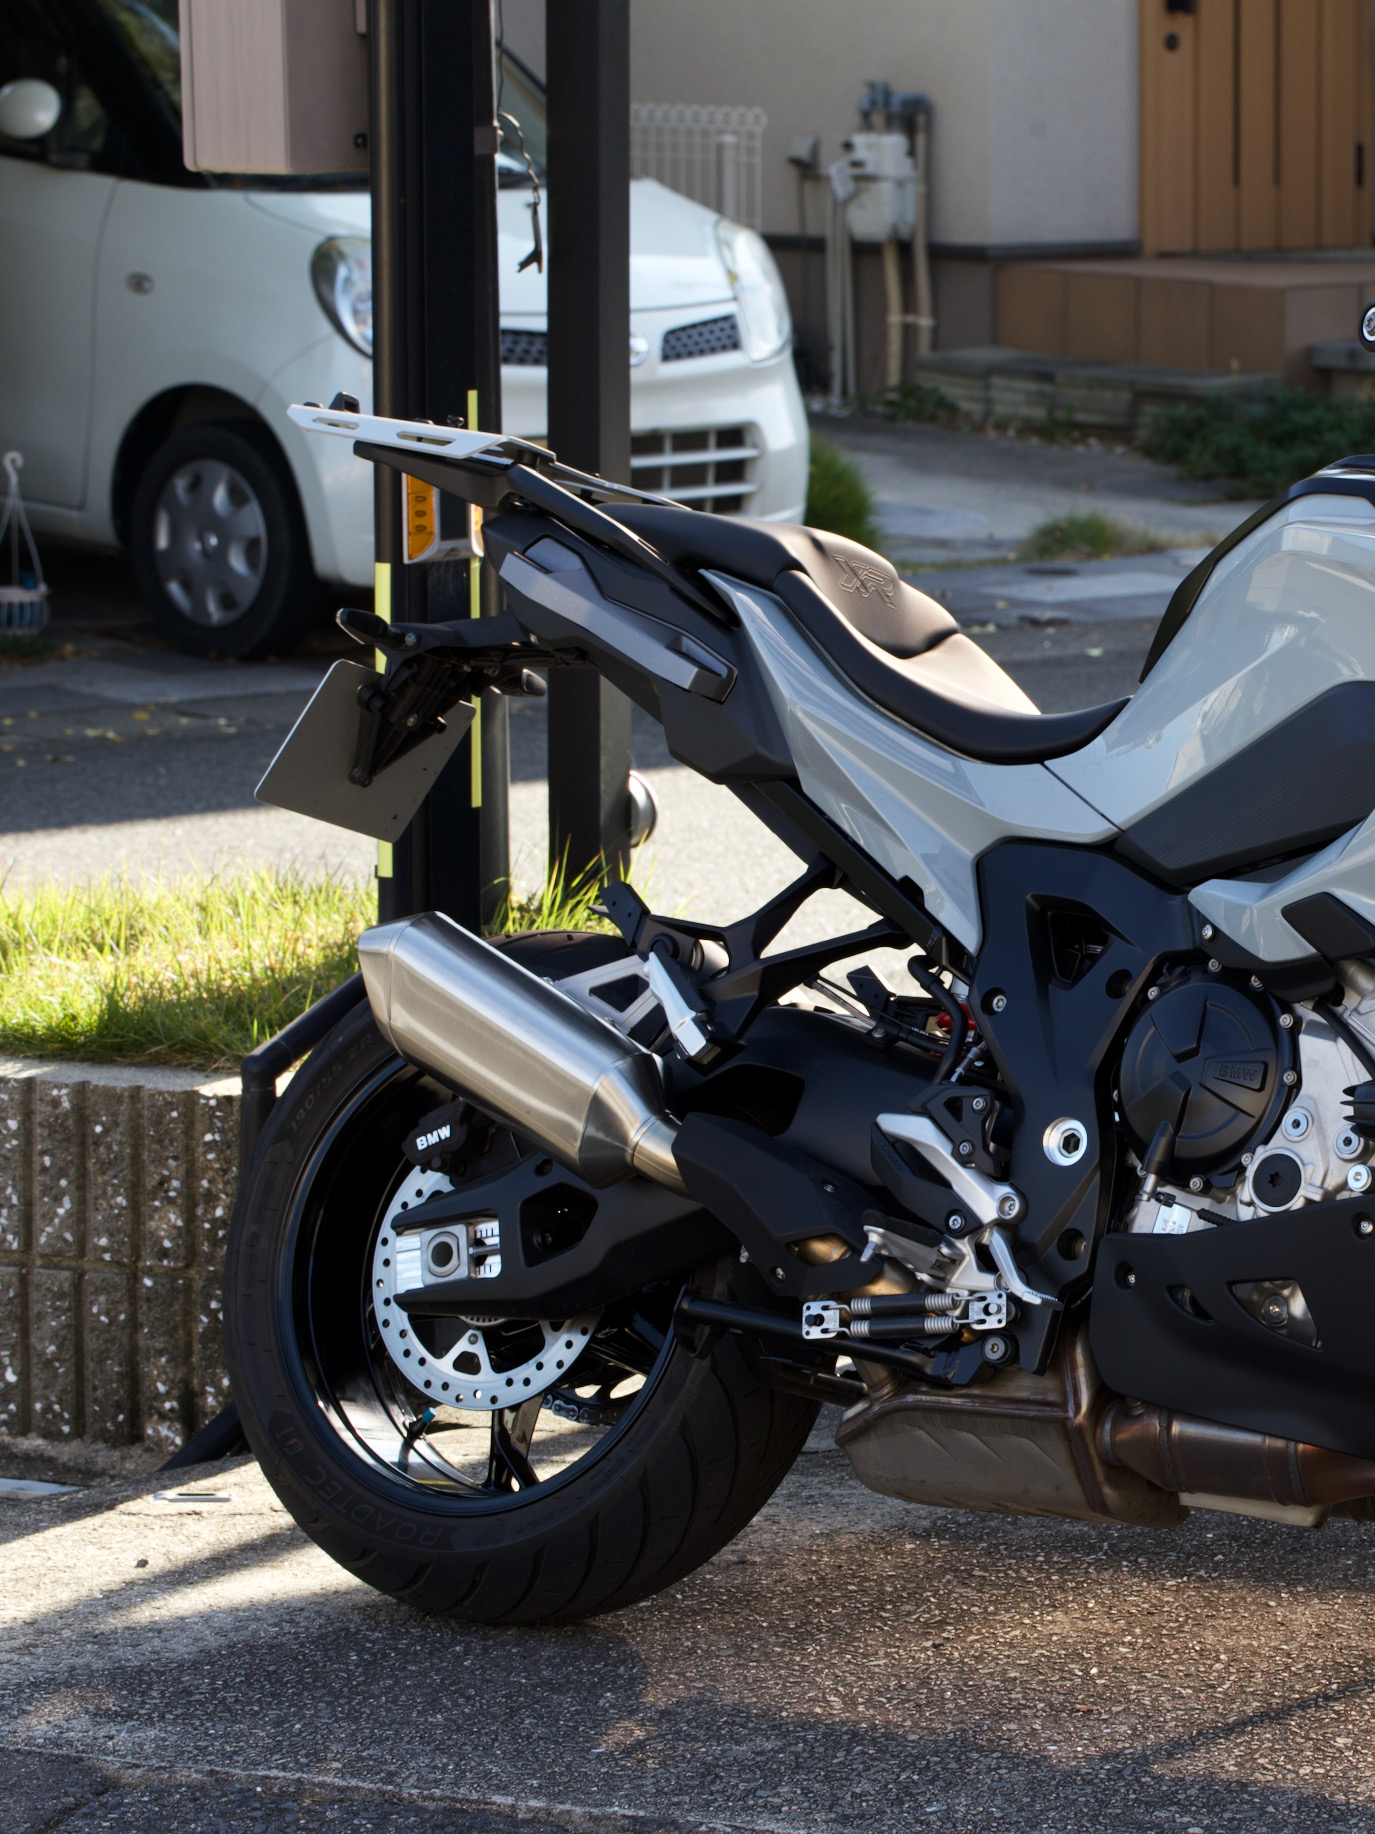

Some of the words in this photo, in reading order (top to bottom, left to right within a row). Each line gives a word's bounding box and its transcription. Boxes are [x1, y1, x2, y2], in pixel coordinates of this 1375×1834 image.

[1219, 1063, 1258, 1081] BMW
[290, 1064, 343, 1133] 190/55
[416, 1124, 451, 1151] BMW
[304, 1464, 443, 1546] ROADTEC
